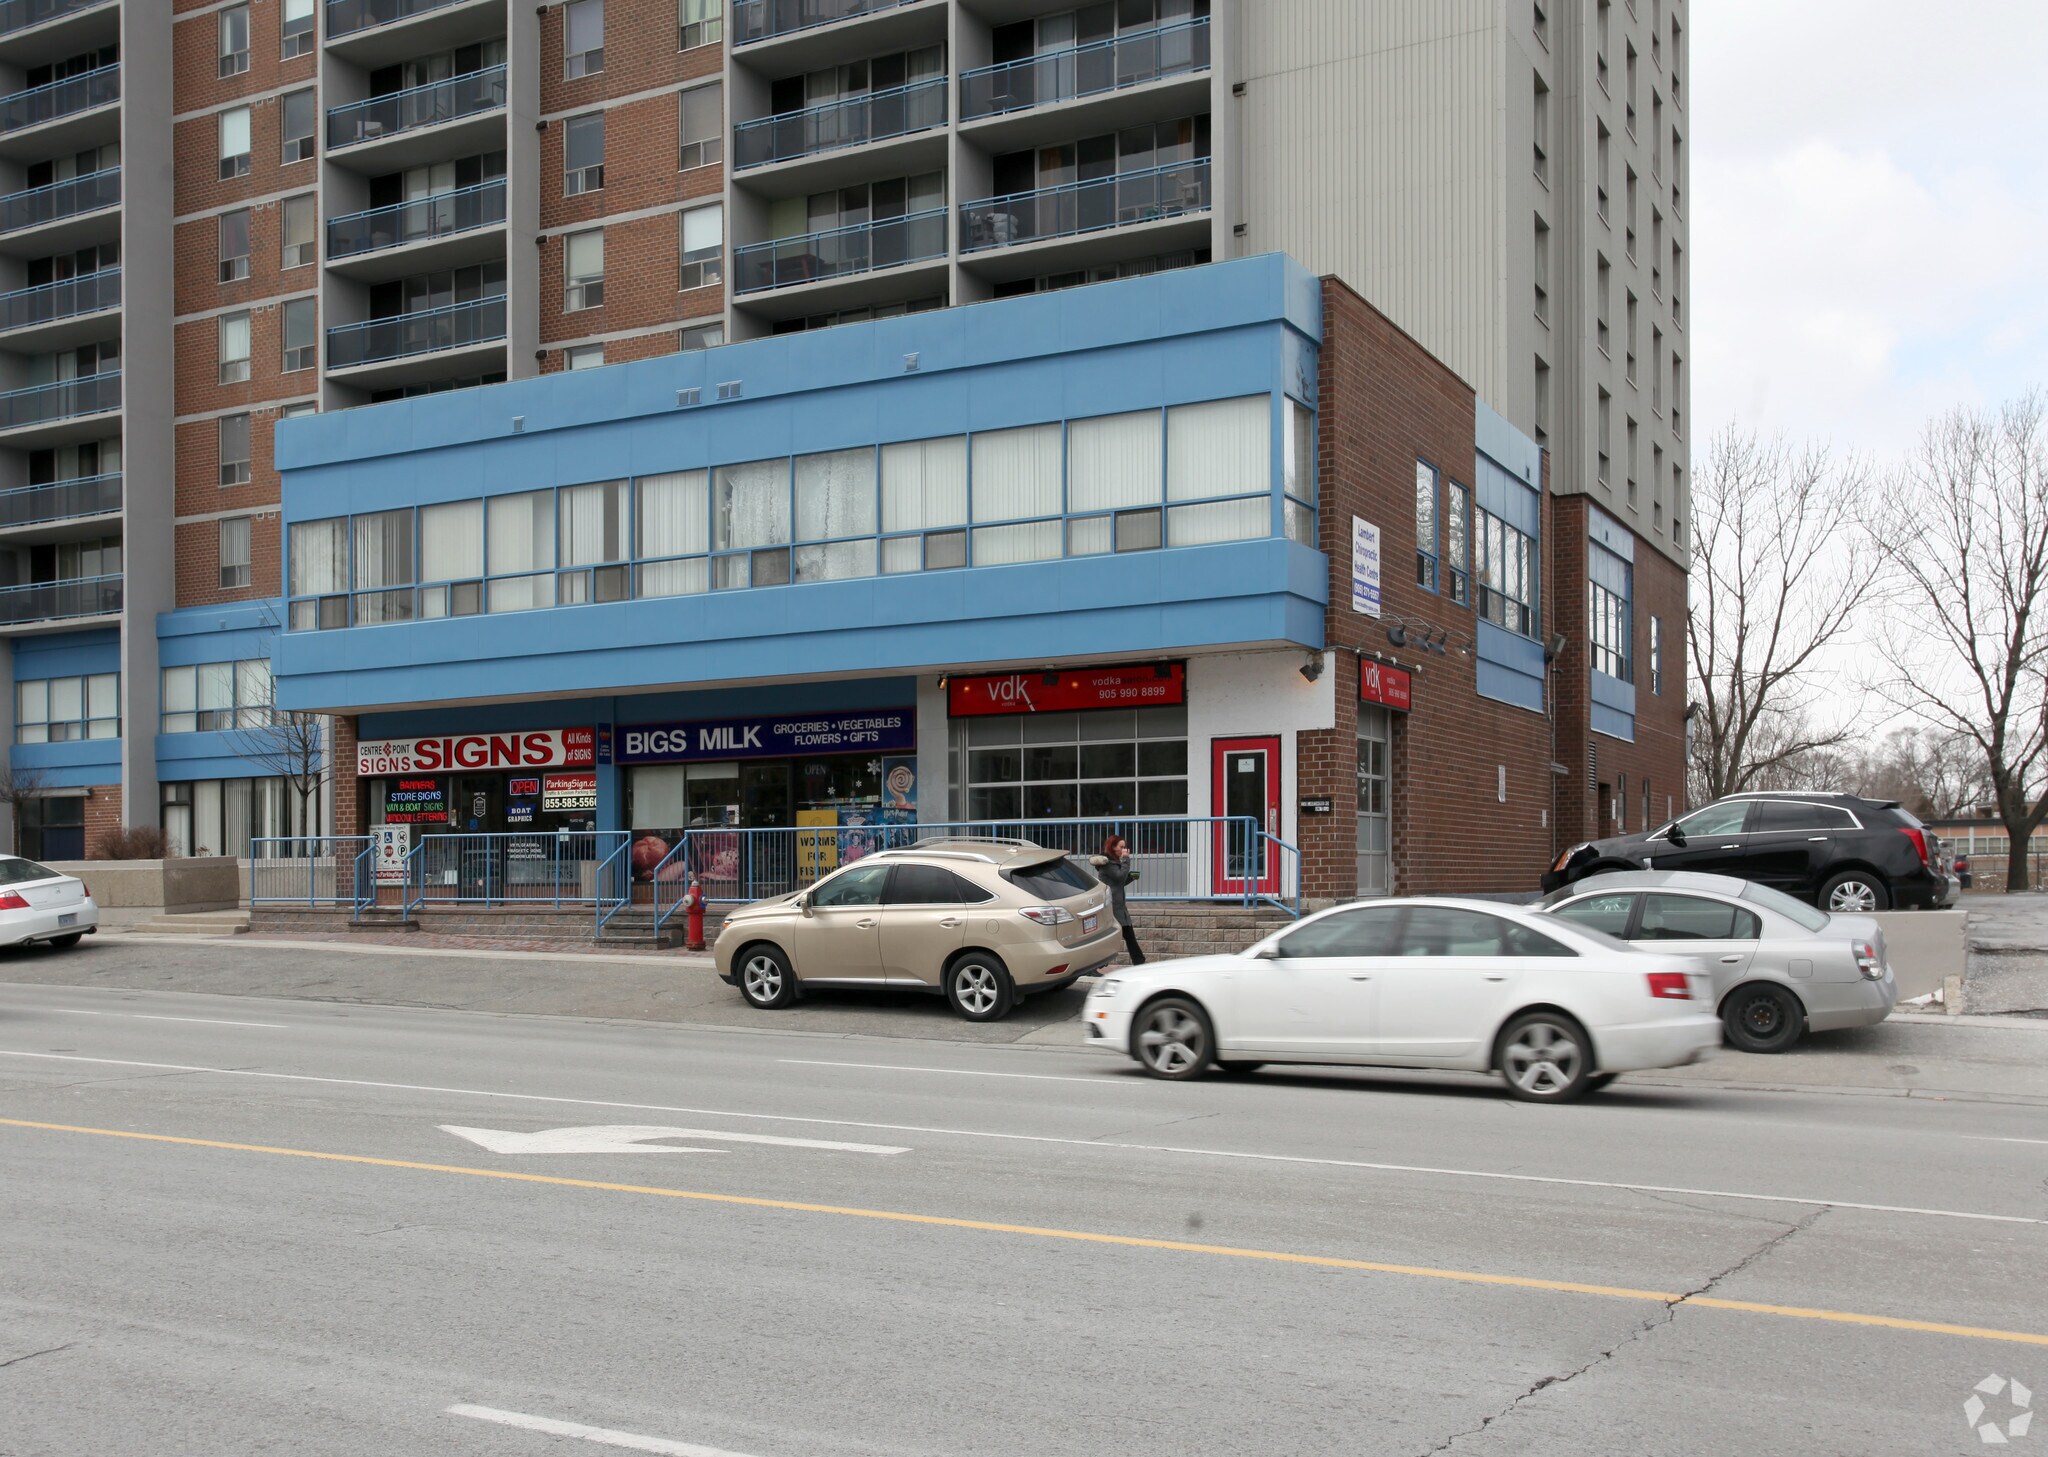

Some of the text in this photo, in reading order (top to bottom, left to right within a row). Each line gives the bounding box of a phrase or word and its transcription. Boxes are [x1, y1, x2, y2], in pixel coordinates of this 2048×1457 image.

[988, 675, 1035, 711] vdk
[773, 717, 901, 734] GROCERIES VEGETABLES
[567, 732, 576, 744] All
[576, 732, 592, 744] Kinds
[626, 730, 687, 755] BIGS
[700, 726, 762, 750] MILK
[794, 731, 879, 746] FLOWERS GIFTS
[360, 744, 410, 756] CENTRE POINT
[413, 733, 554, 770] SIGNS
[567, 749, 574, 760] of
[574, 749, 592, 760] SIGNS
[360, 756, 411, 773] SIGNS
[805, 764, 826, 775] OPEN
[400, 781, 436, 790] BANNERS
[511, 781, 537, 794] OPEN
[391, 791, 442, 802] STORE SIGNS
[399, 804, 405, 812] &
[405, 803, 421, 812] BOAT
[423, 802, 444, 811] SIGNS
[412, 811, 448, 822] LETTERING
[508, 815, 533, 823] GRAPHICS
[800, 836, 835, 846] WORMS
[807, 851, 827, 861] FOR
